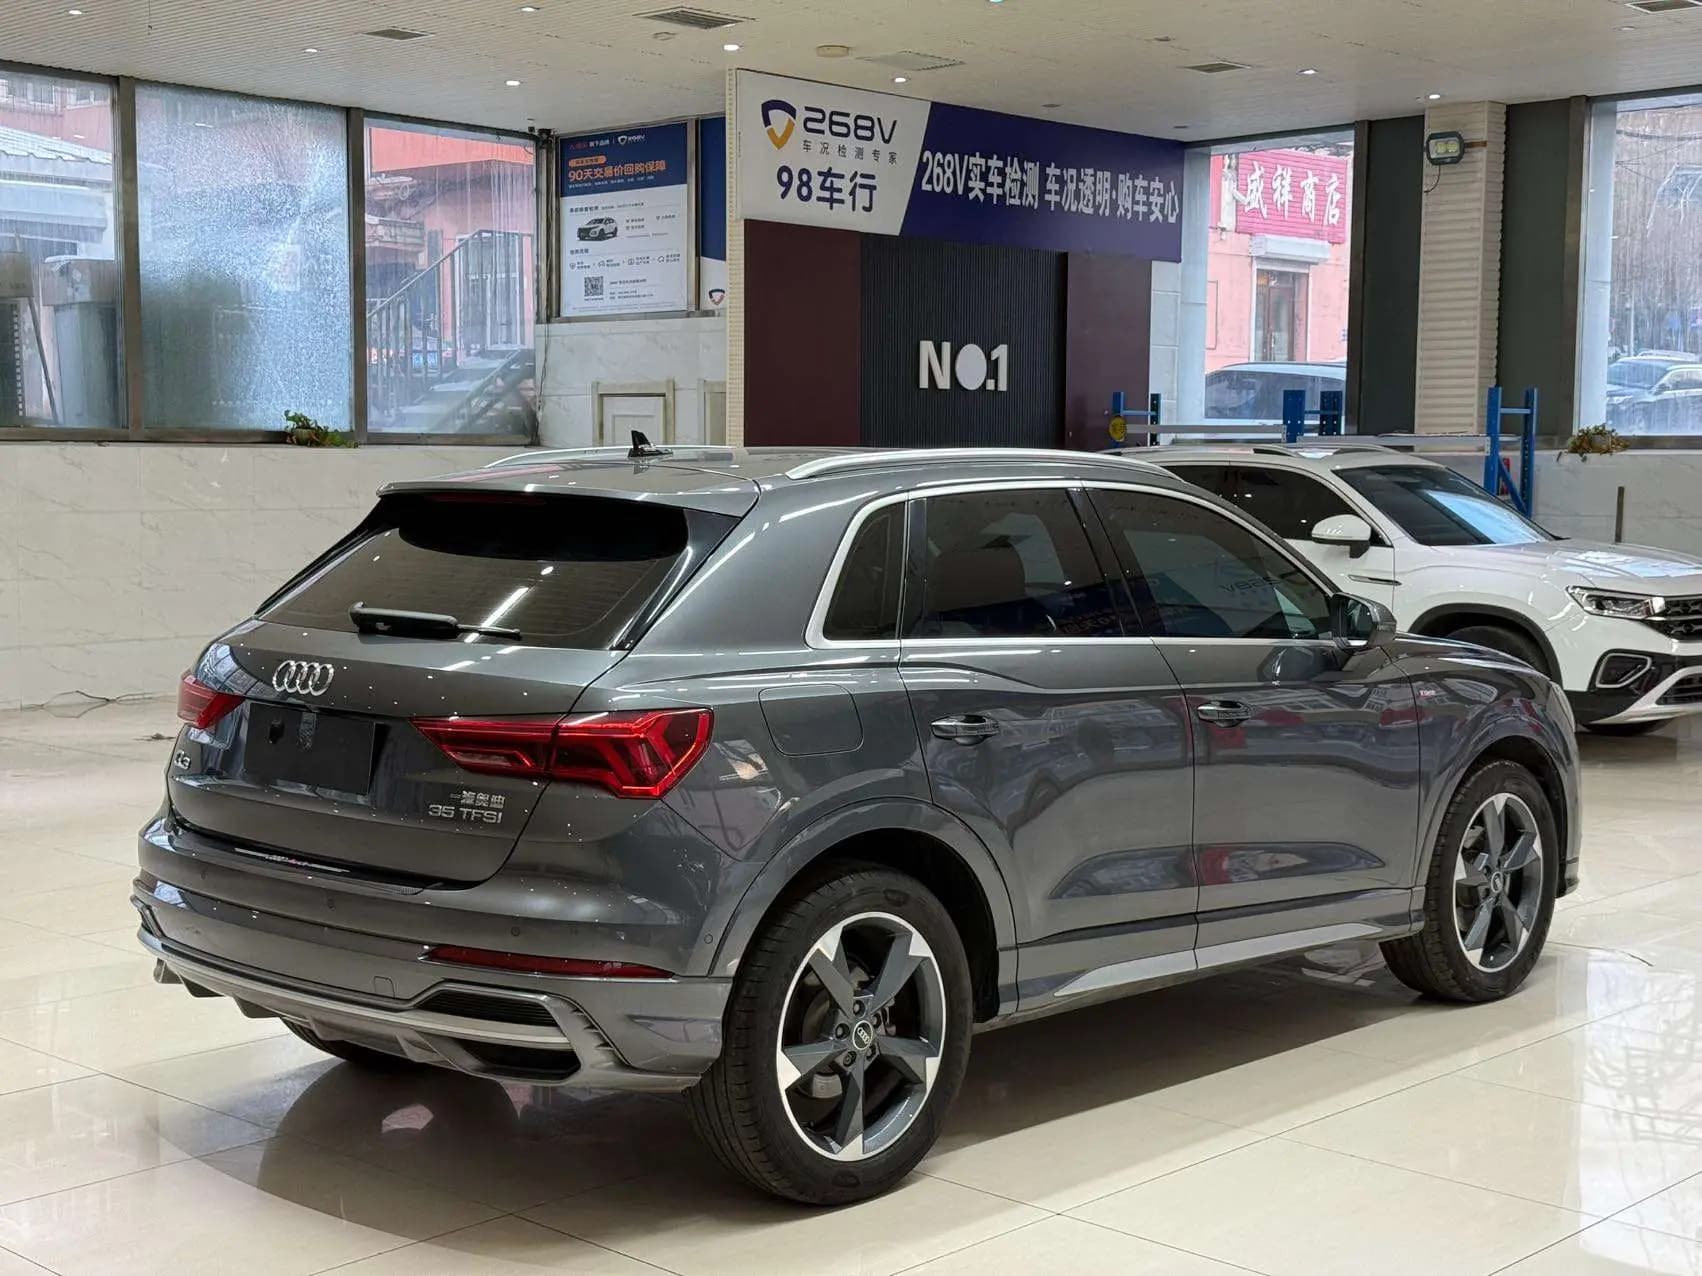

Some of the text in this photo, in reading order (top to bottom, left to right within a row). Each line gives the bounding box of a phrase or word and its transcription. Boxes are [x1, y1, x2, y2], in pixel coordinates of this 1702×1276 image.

[803, 106, 897, 144] 268V
[568, 160, 667, 182] 90天交易价回购保障
[803, 139, 897, 165] 车况检测专家
[777, 165, 877, 212] 98车行
[921, 150, 1039, 209] 268V实车检测
[919, 340, 1008, 391] NO.1
[428, 804, 502, 824] 35 TFSI
